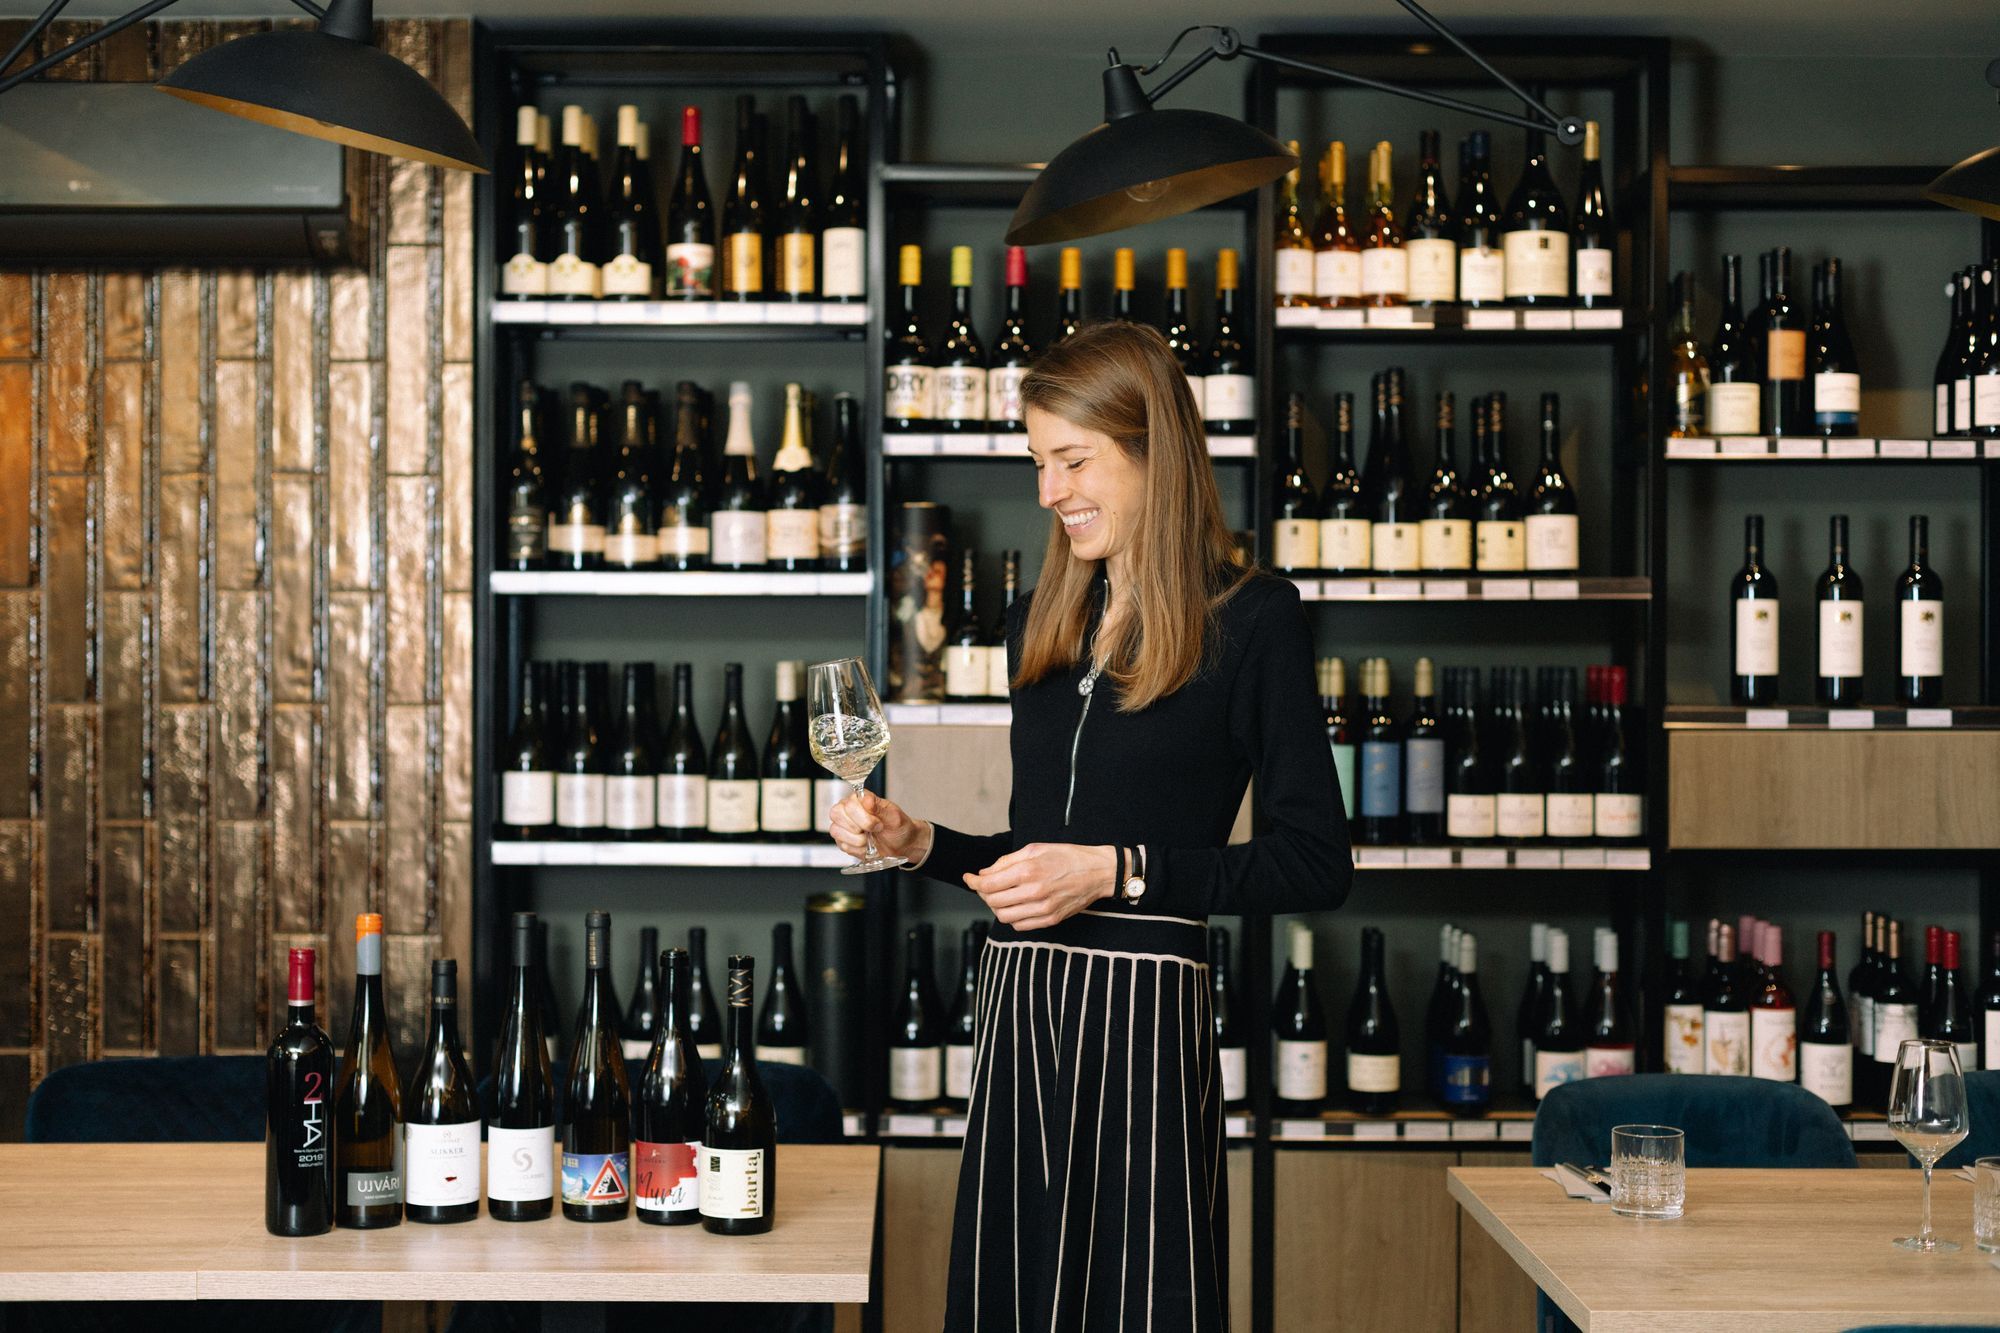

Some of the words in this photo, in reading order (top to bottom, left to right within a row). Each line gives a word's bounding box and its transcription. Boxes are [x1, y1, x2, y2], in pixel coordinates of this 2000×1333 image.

[887, 373, 926, 391] DRY
[298, 1153, 324, 1162] 2019
[740, 1155, 759, 1213] barta
